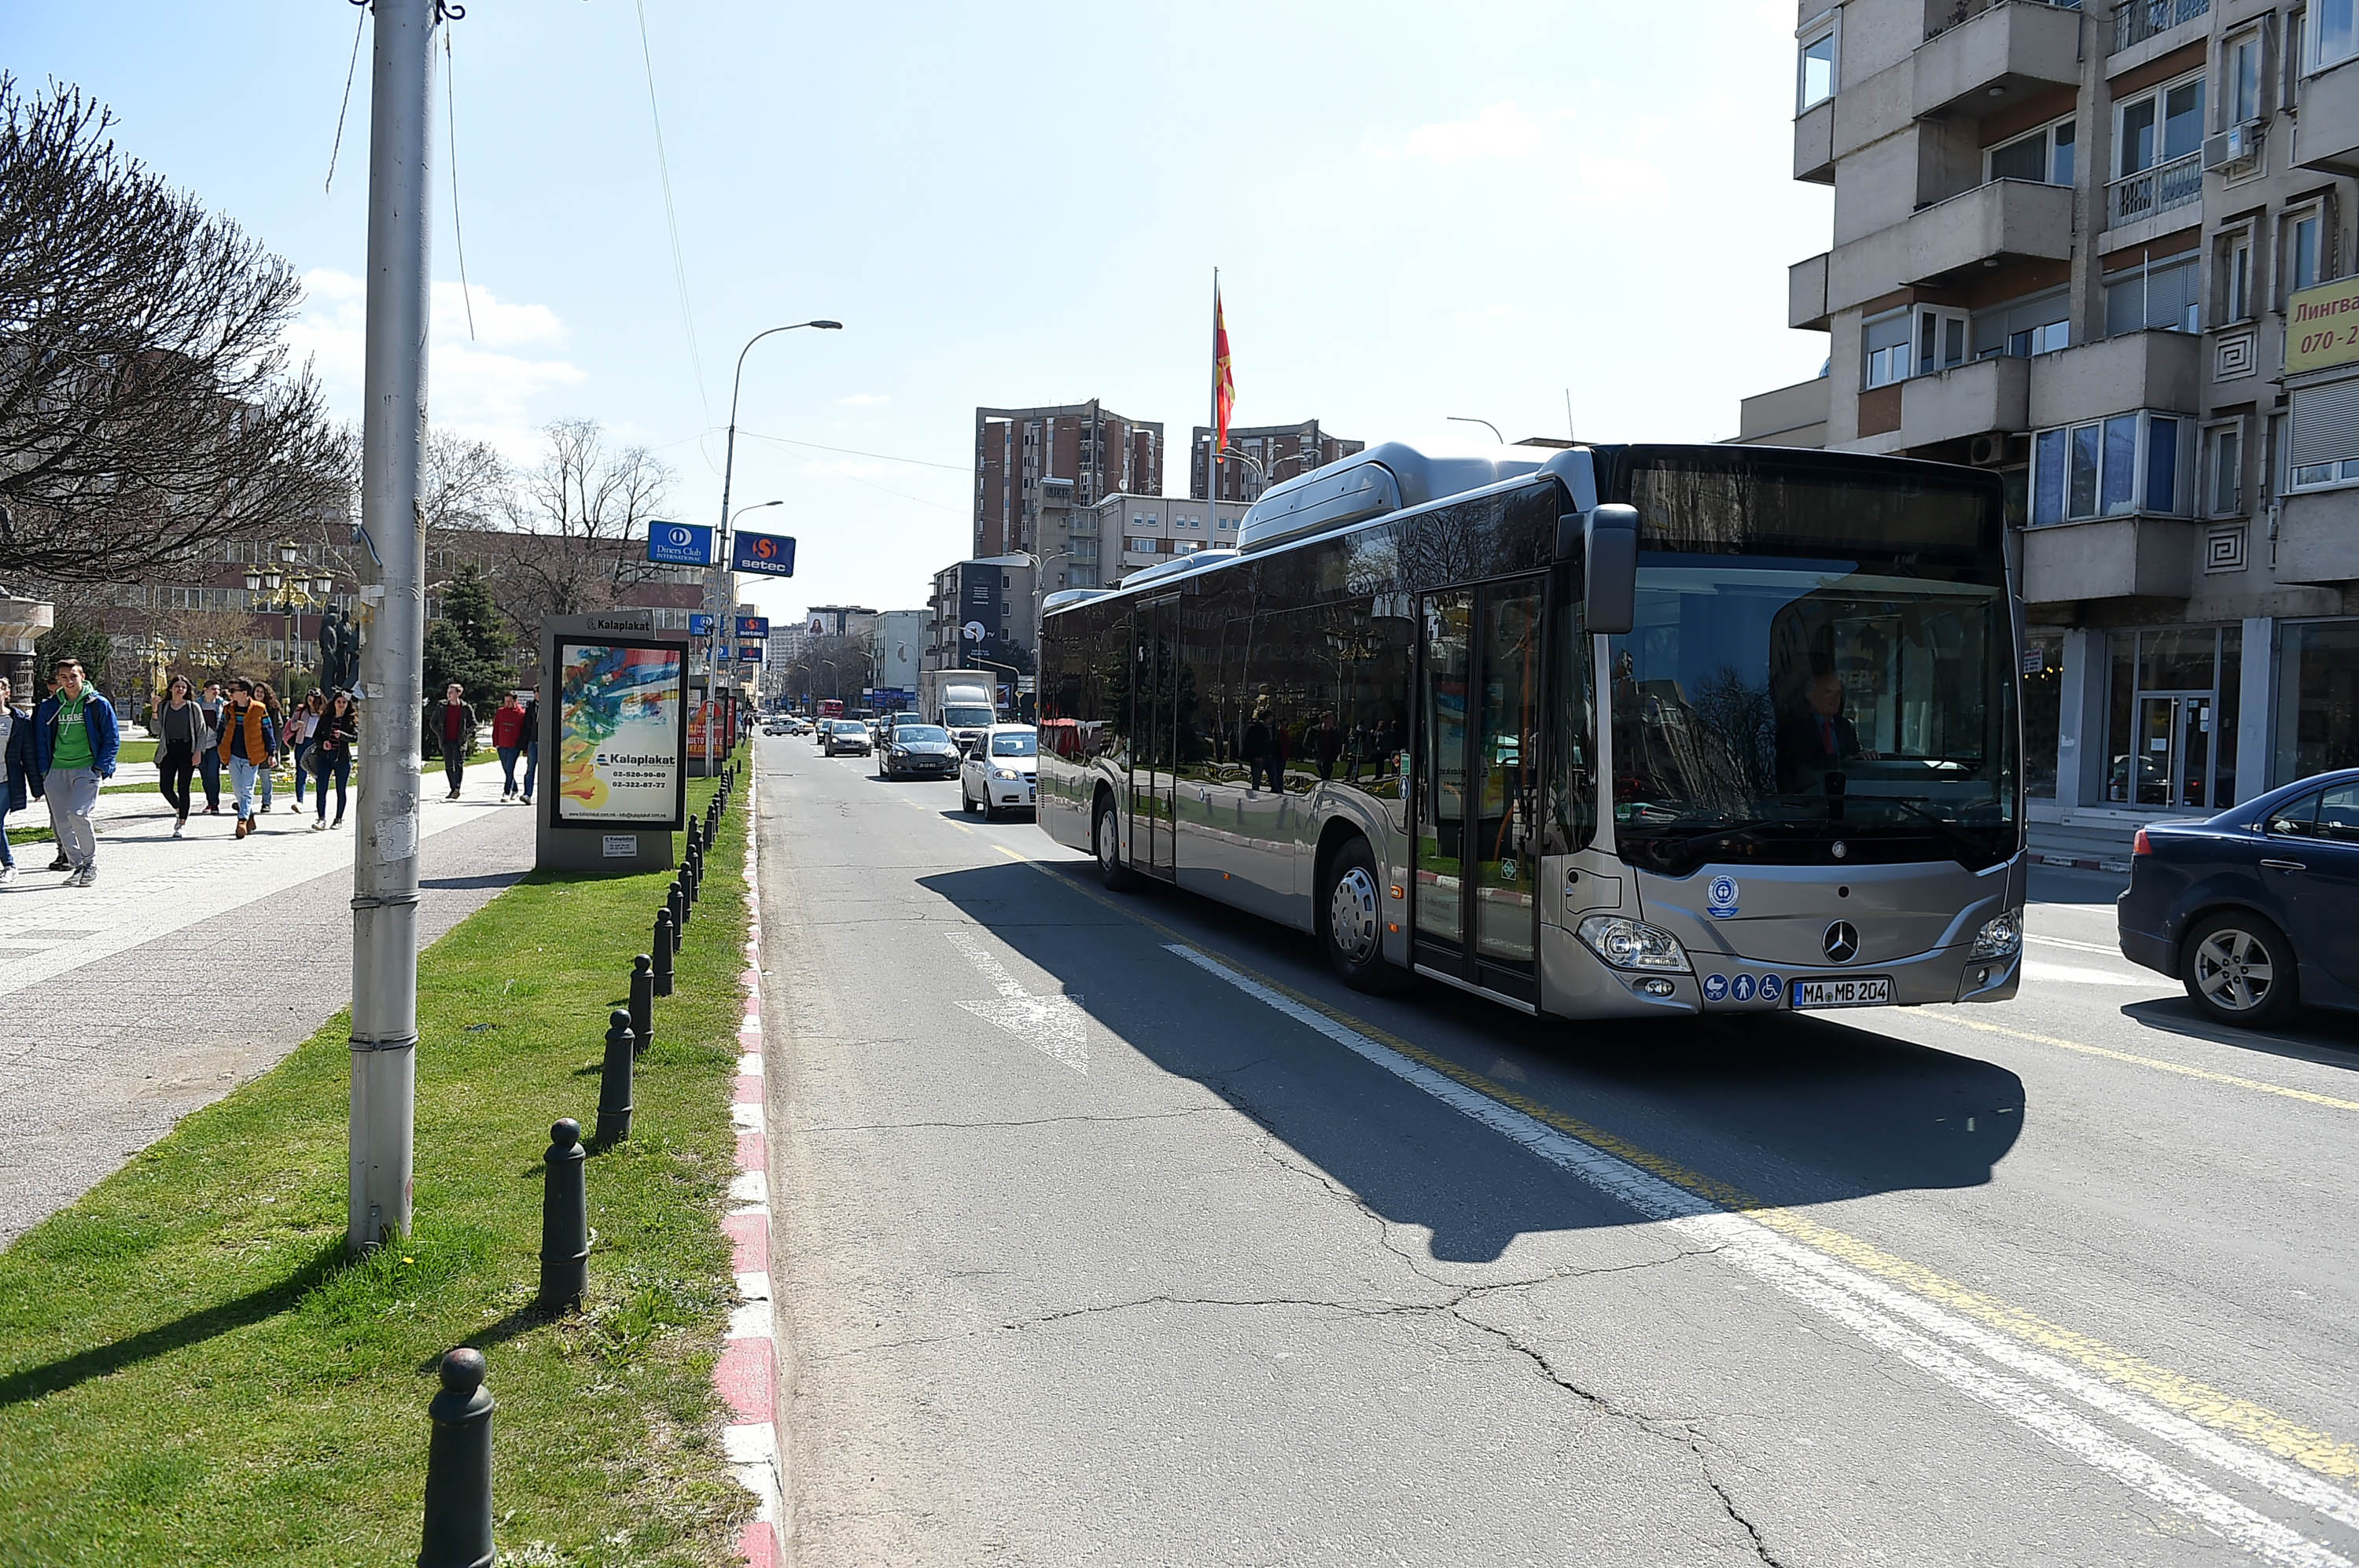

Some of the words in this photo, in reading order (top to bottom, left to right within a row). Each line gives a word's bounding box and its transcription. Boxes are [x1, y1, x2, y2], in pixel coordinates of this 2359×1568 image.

[656, 553, 701, 562] INTERNATIONAL
[657, 545, 682, 557] Diners
[683, 547, 701, 558] Club
[742, 559, 786, 572] setec
[598, 620, 650, 632] Kalaplakat
[610, 753, 675, 767] Kalaplakat
[1803, 984, 1824, 1003] MA
[1835, 983, 1855, 1002] MB
[1858, 981, 1886, 1001] 204
